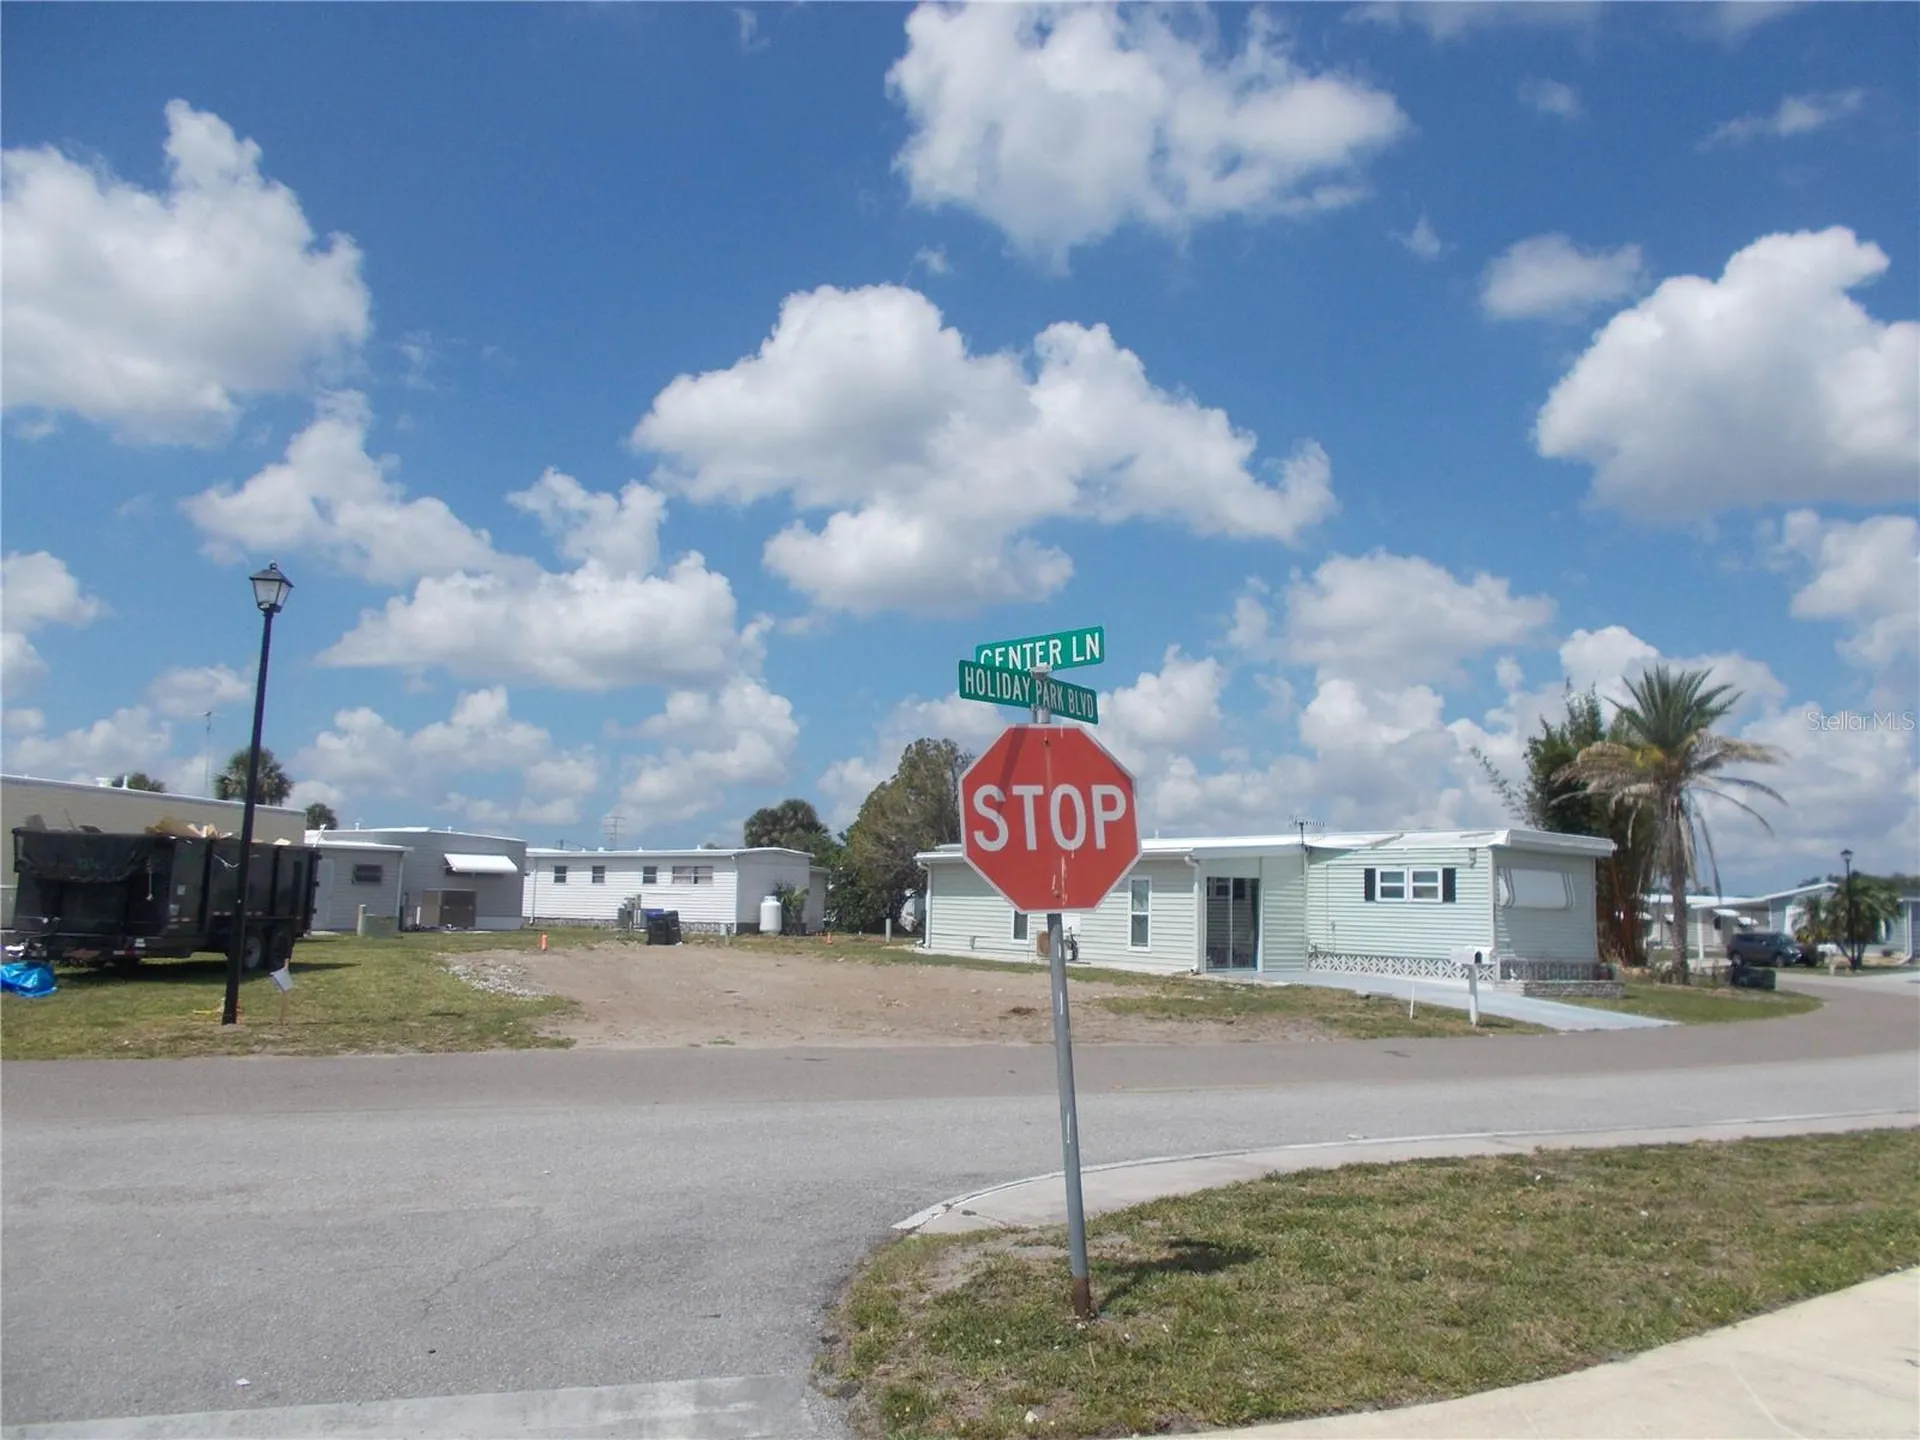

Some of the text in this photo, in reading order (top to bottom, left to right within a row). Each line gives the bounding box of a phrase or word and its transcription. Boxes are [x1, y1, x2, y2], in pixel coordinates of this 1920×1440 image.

[980, 632, 1100, 671] CENTER LN
[964, 667, 1094, 718] HOLIDAY PARK BLVD
[973, 784, 1127, 852] STOP
